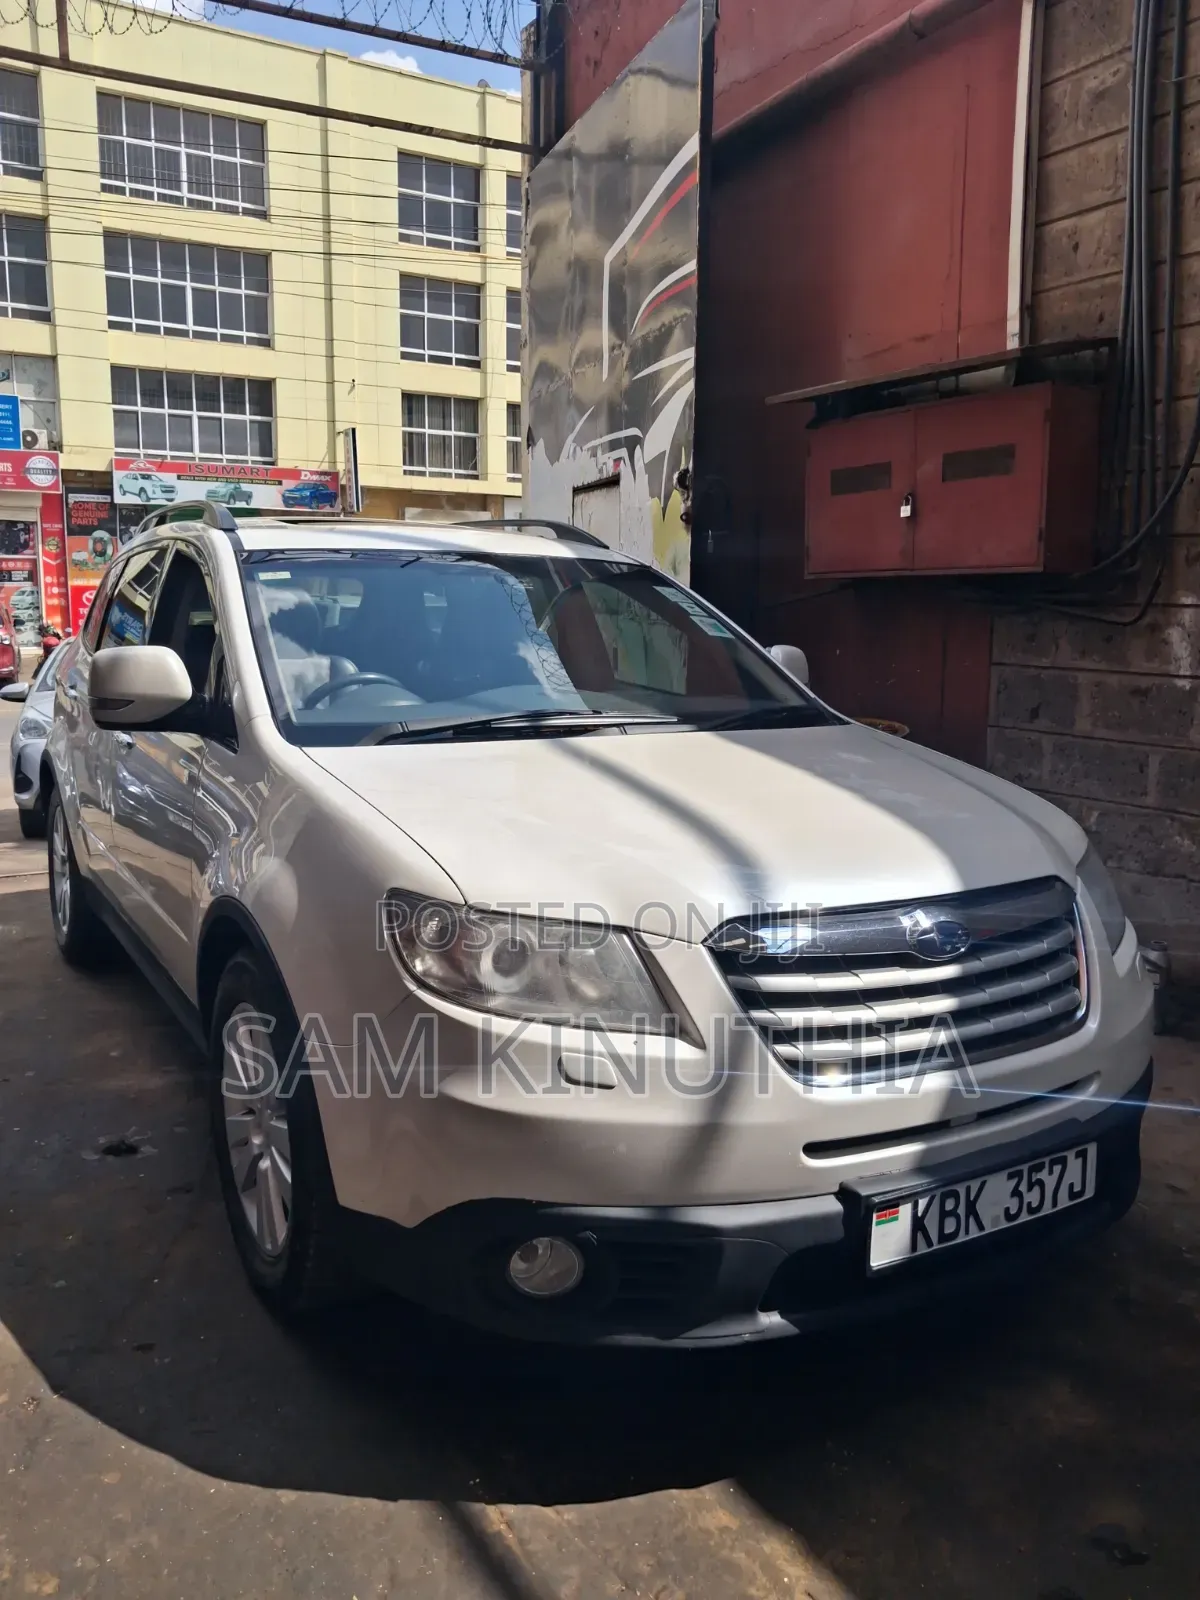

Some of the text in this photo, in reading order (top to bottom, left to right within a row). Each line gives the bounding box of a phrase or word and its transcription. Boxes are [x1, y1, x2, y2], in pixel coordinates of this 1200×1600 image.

[187, 463, 272, 478] ISUMART
[71, 502, 97, 510] HOME
[71, 510, 109, 519] GENUINE
[71, 518, 99, 526] PARTS
[910, 1147, 1089, 1253] KBK 357J
